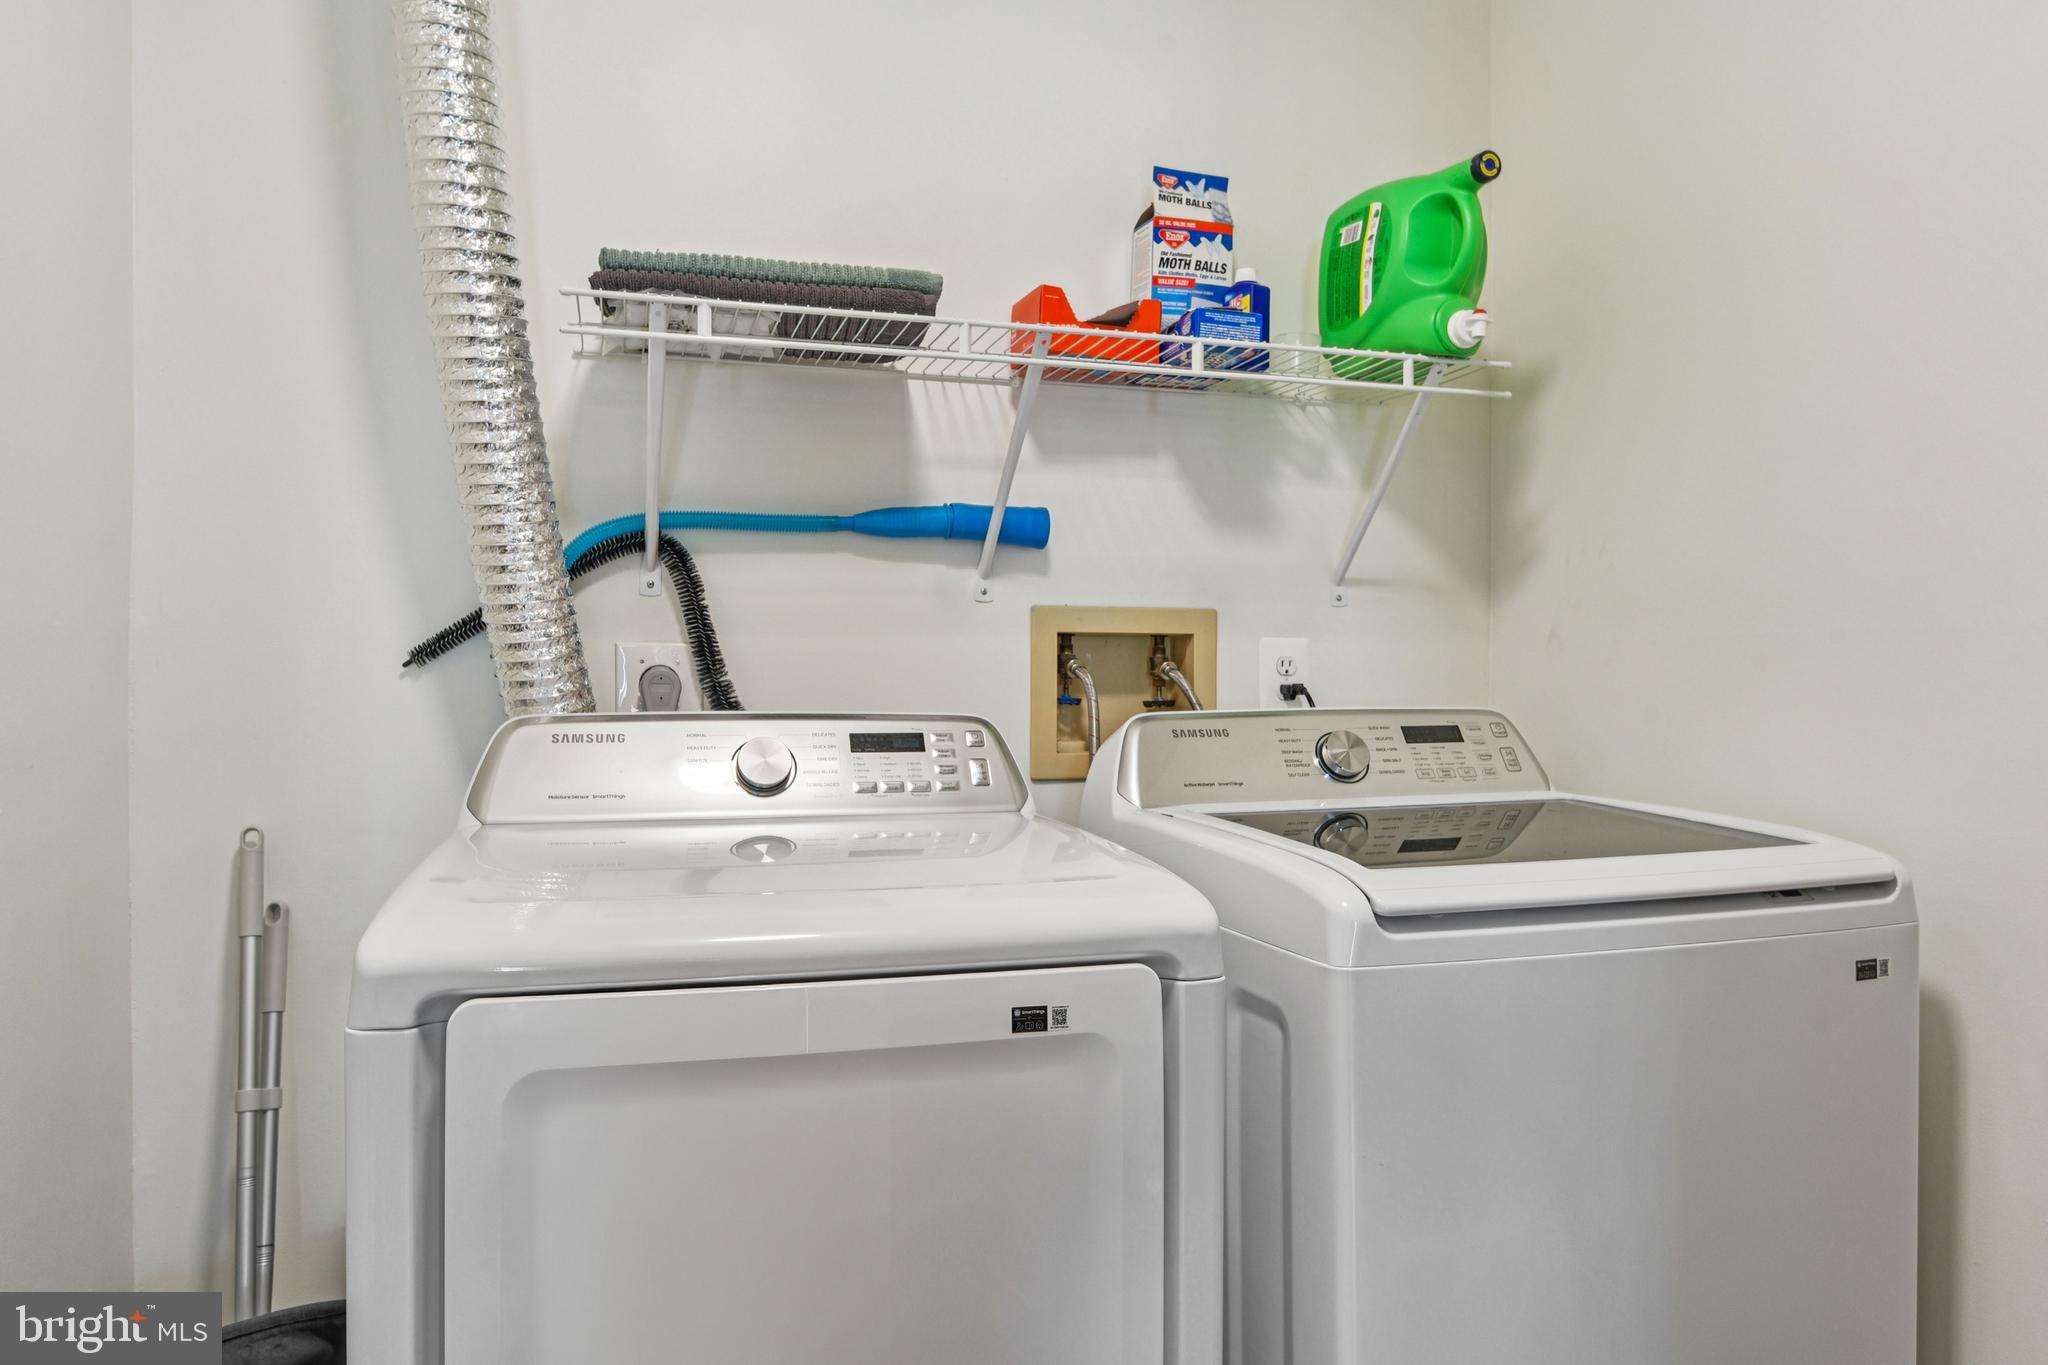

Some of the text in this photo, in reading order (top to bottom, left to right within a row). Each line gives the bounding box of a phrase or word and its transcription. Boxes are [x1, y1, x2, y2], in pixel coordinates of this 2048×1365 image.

[1158, 193, 1212, 210] MOTH BALLS
[1158, 257, 1227, 274] MOTH BALLS
[551, 733, 626, 744] SAMSUNG
[1171, 728, 1230, 739] SAMSUNG
